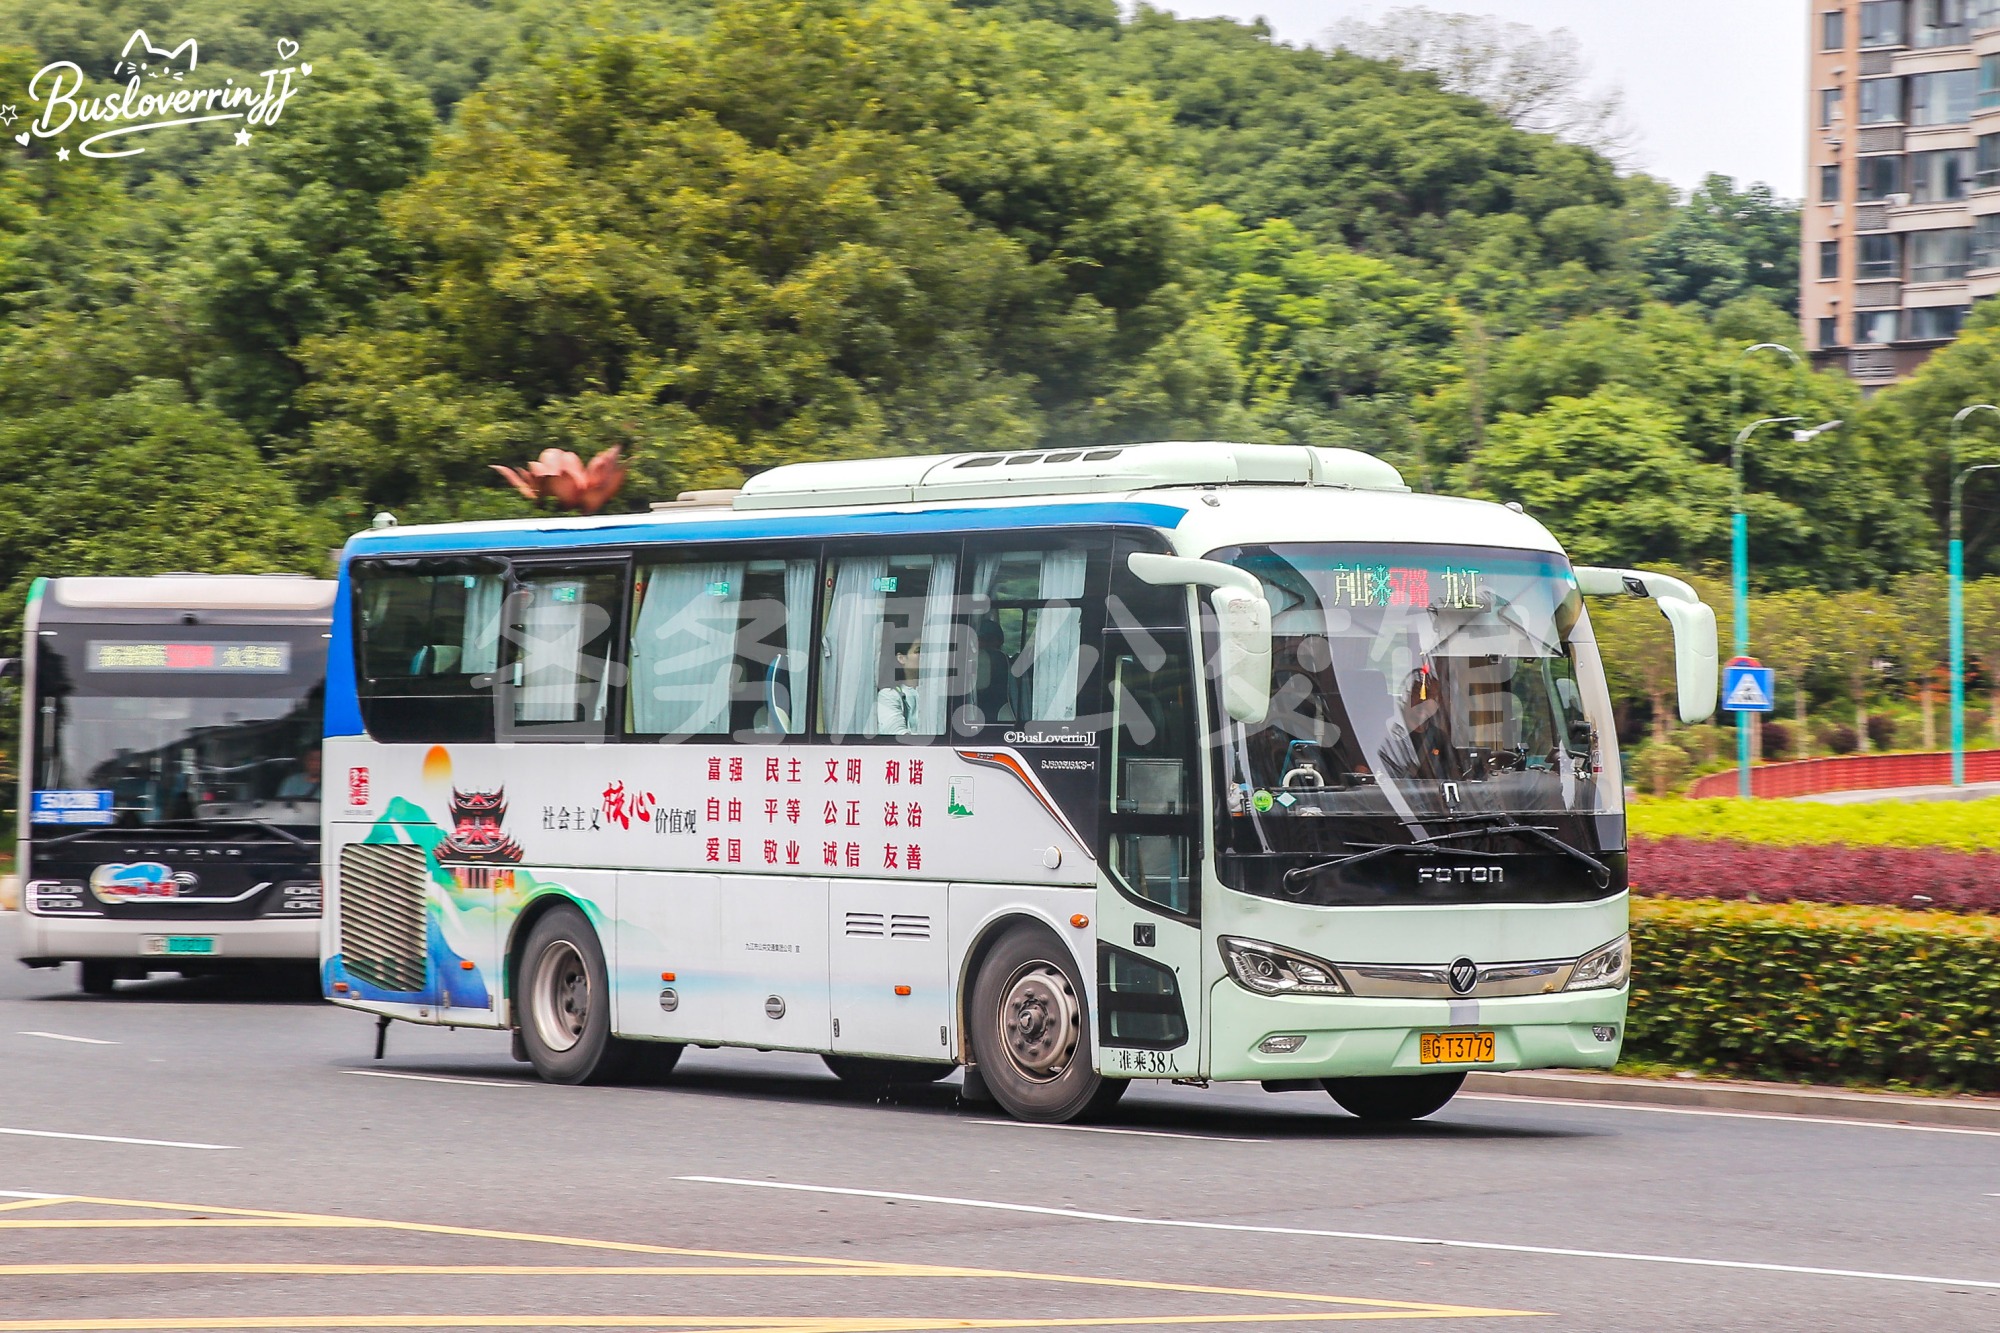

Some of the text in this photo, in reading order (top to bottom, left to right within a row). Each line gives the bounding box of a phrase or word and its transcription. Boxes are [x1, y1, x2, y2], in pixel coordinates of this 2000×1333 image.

[707, 756, 924, 785] 富强 民主 文明 和谐
[542, 780, 697, 833] 社会主义核心价值观
[706, 797, 922, 828] 自由 平等 公正 法治
[705, 837, 922, 870] 爱国 敬业 诚信 友善
[1419, 866, 1503, 883] FOTON
